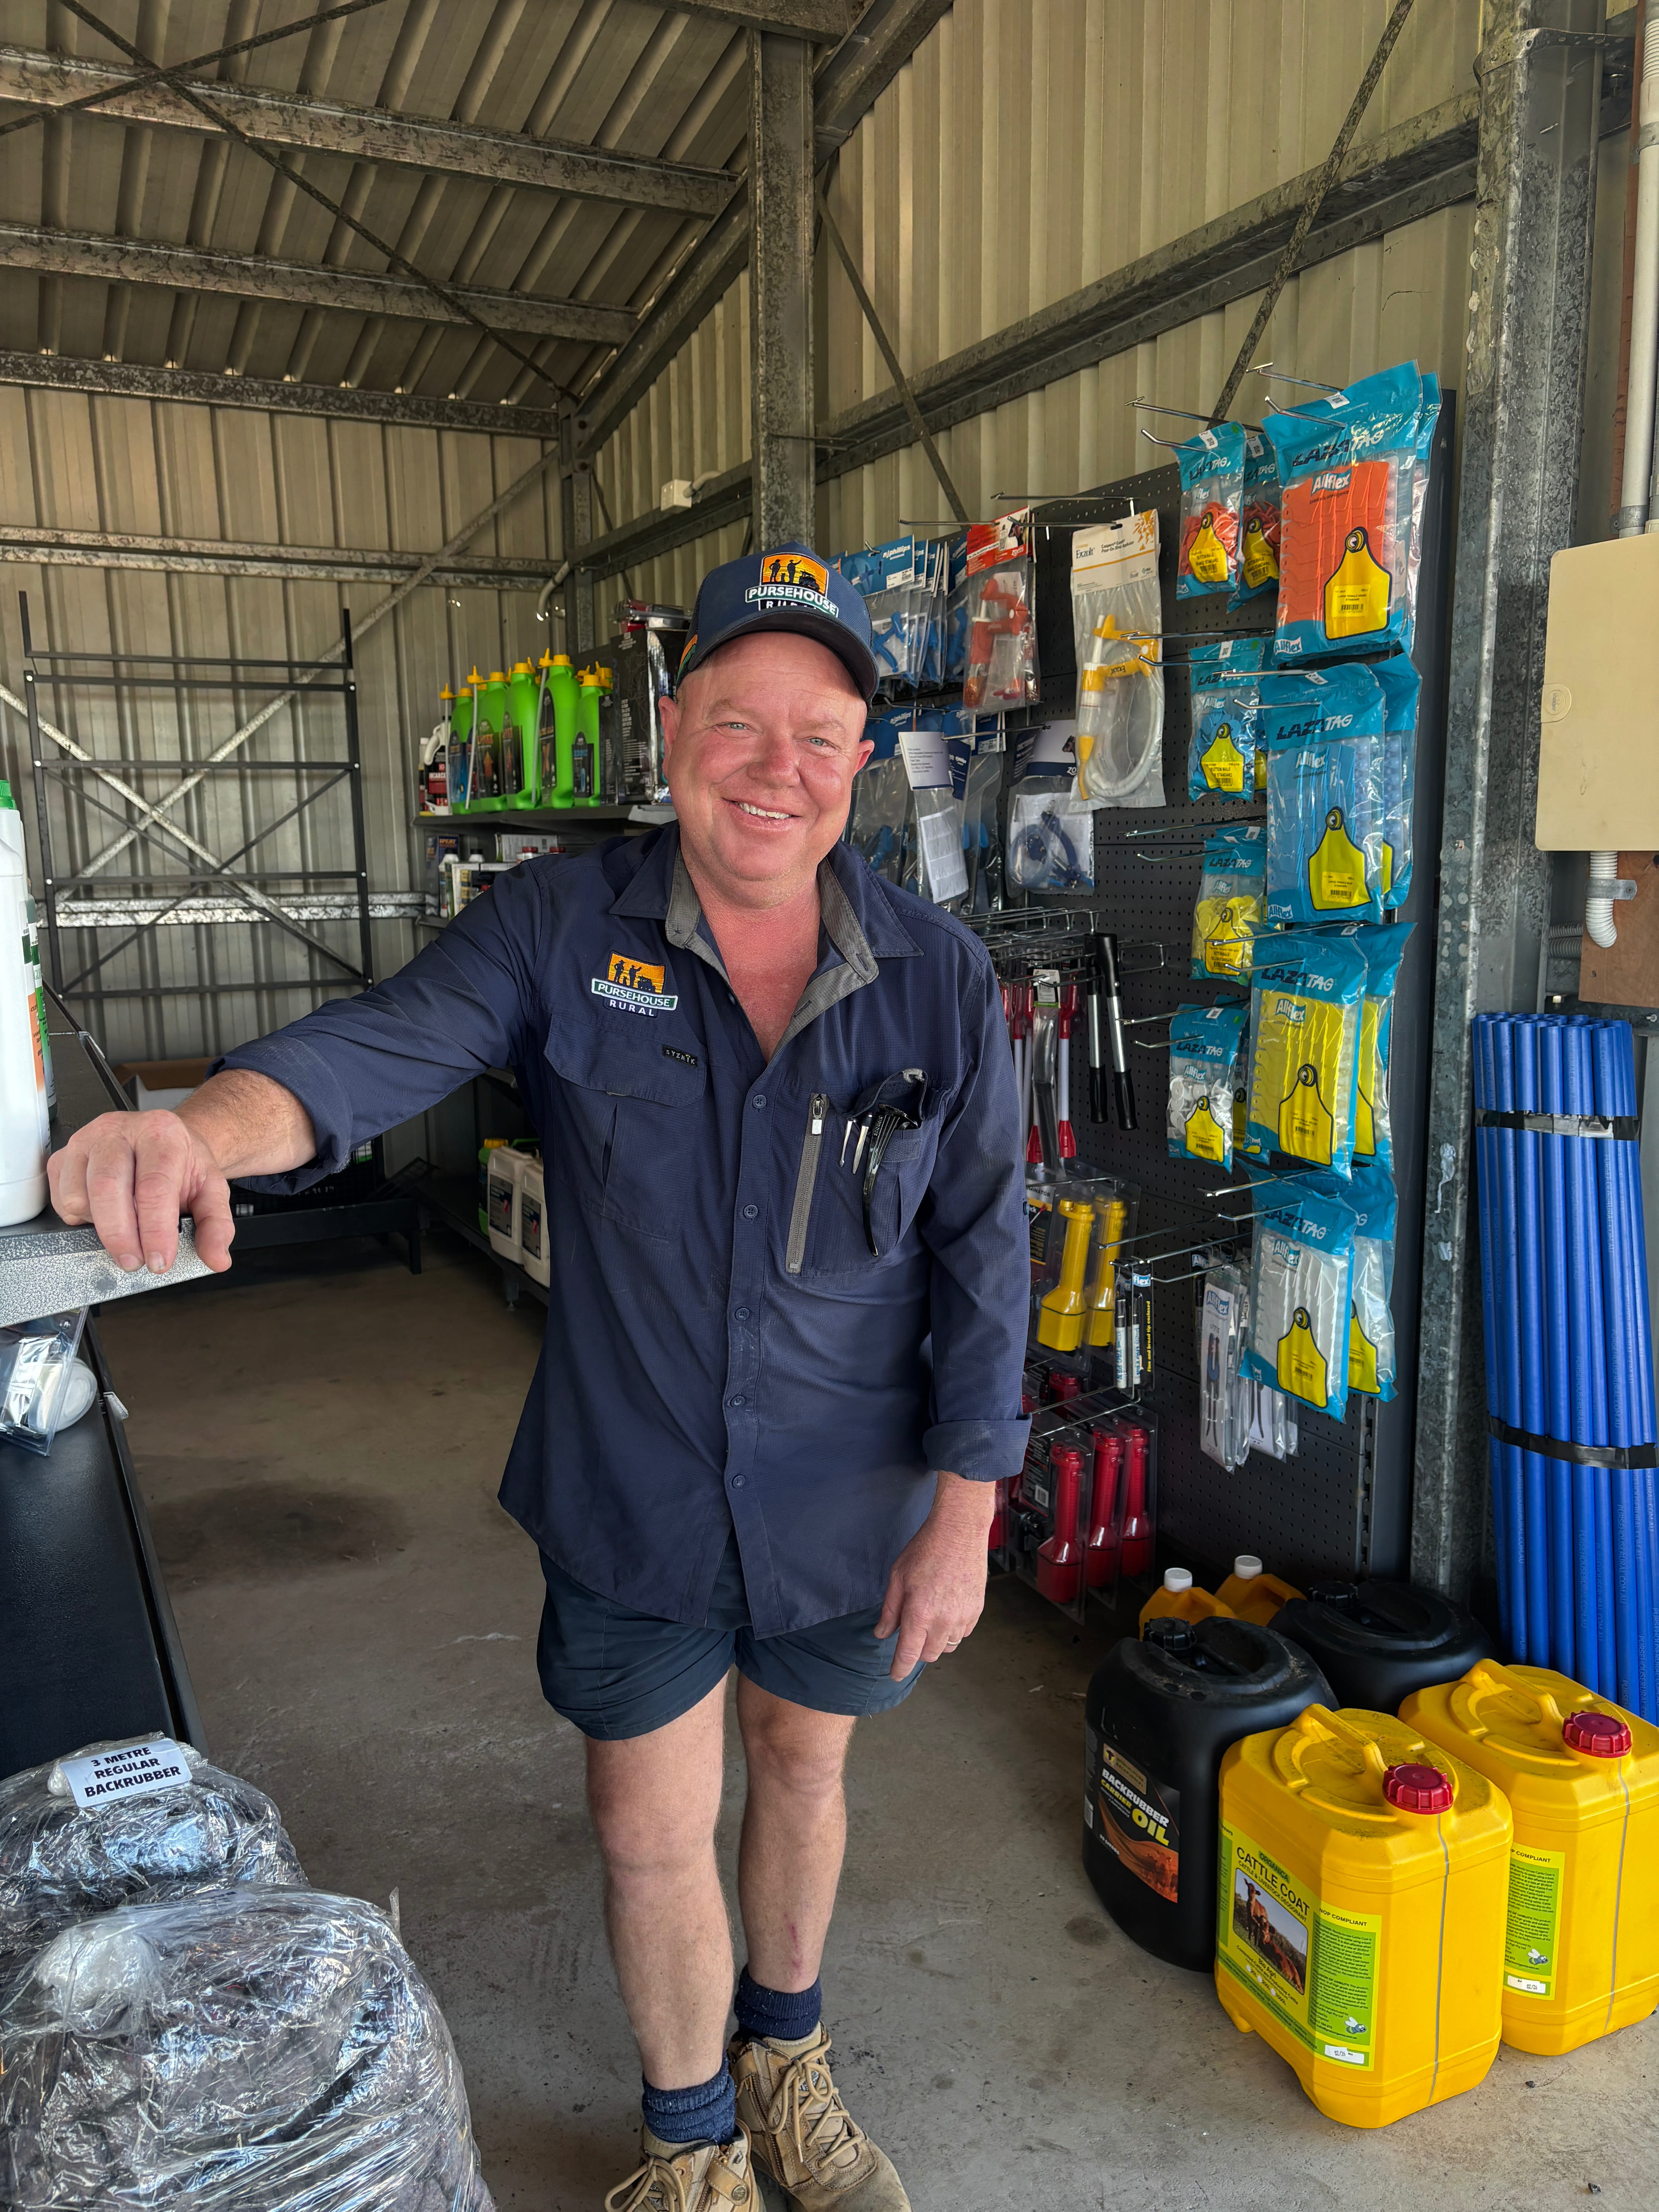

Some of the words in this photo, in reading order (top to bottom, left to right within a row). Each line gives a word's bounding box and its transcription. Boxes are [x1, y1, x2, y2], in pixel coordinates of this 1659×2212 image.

[1312, 471, 1350, 493] Allflex
[1076, 547, 1094, 559] Exzolt
[749, 586, 837, 614] PURSEHOUSE
[1276, 714, 1353, 740] LAZATAG
[1268, 905, 1292, 919] Allflex
[1261, 968, 1334, 992] LAZATAG
[598, 984, 670, 1007] PURSEHOUSE
[610, 1000, 654, 1017] RURAL
[1275, 1000, 1305, 1021] Allflex
[666, 1049, 695, 1065] SYZMIK
[1176, 1042, 1222, 1056] LAZATAG
[1184, 1066, 1206, 1081] Allflex
[1027, 1186, 1051, 1197] MINATOR
[1273, 1241, 1300, 1265] Allflex
[1617, 1504, 1626, 1604] PURSEHOUSERURAL.COM.AU
[104, 1747, 152, 1764] METRE
[94, 1758, 161, 1779] REGULAR
[84, 1766, 182, 1798] BACKRUBBER
[1101, 1779, 1132, 1809] CARRIER
[1102, 1768, 1170, 1828] BACKRUBBER
[1132, 1808, 1170, 1846] OIL
[1516, 1851, 1551, 1863] COMPLIANT
[1237, 1847, 1278, 1889] CATTLE
[1280, 1883, 1310, 1916] COAT
[1319, 1908, 1331, 1916] NOP
[1331, 1913, 1367, 1927] COMPLIANT
